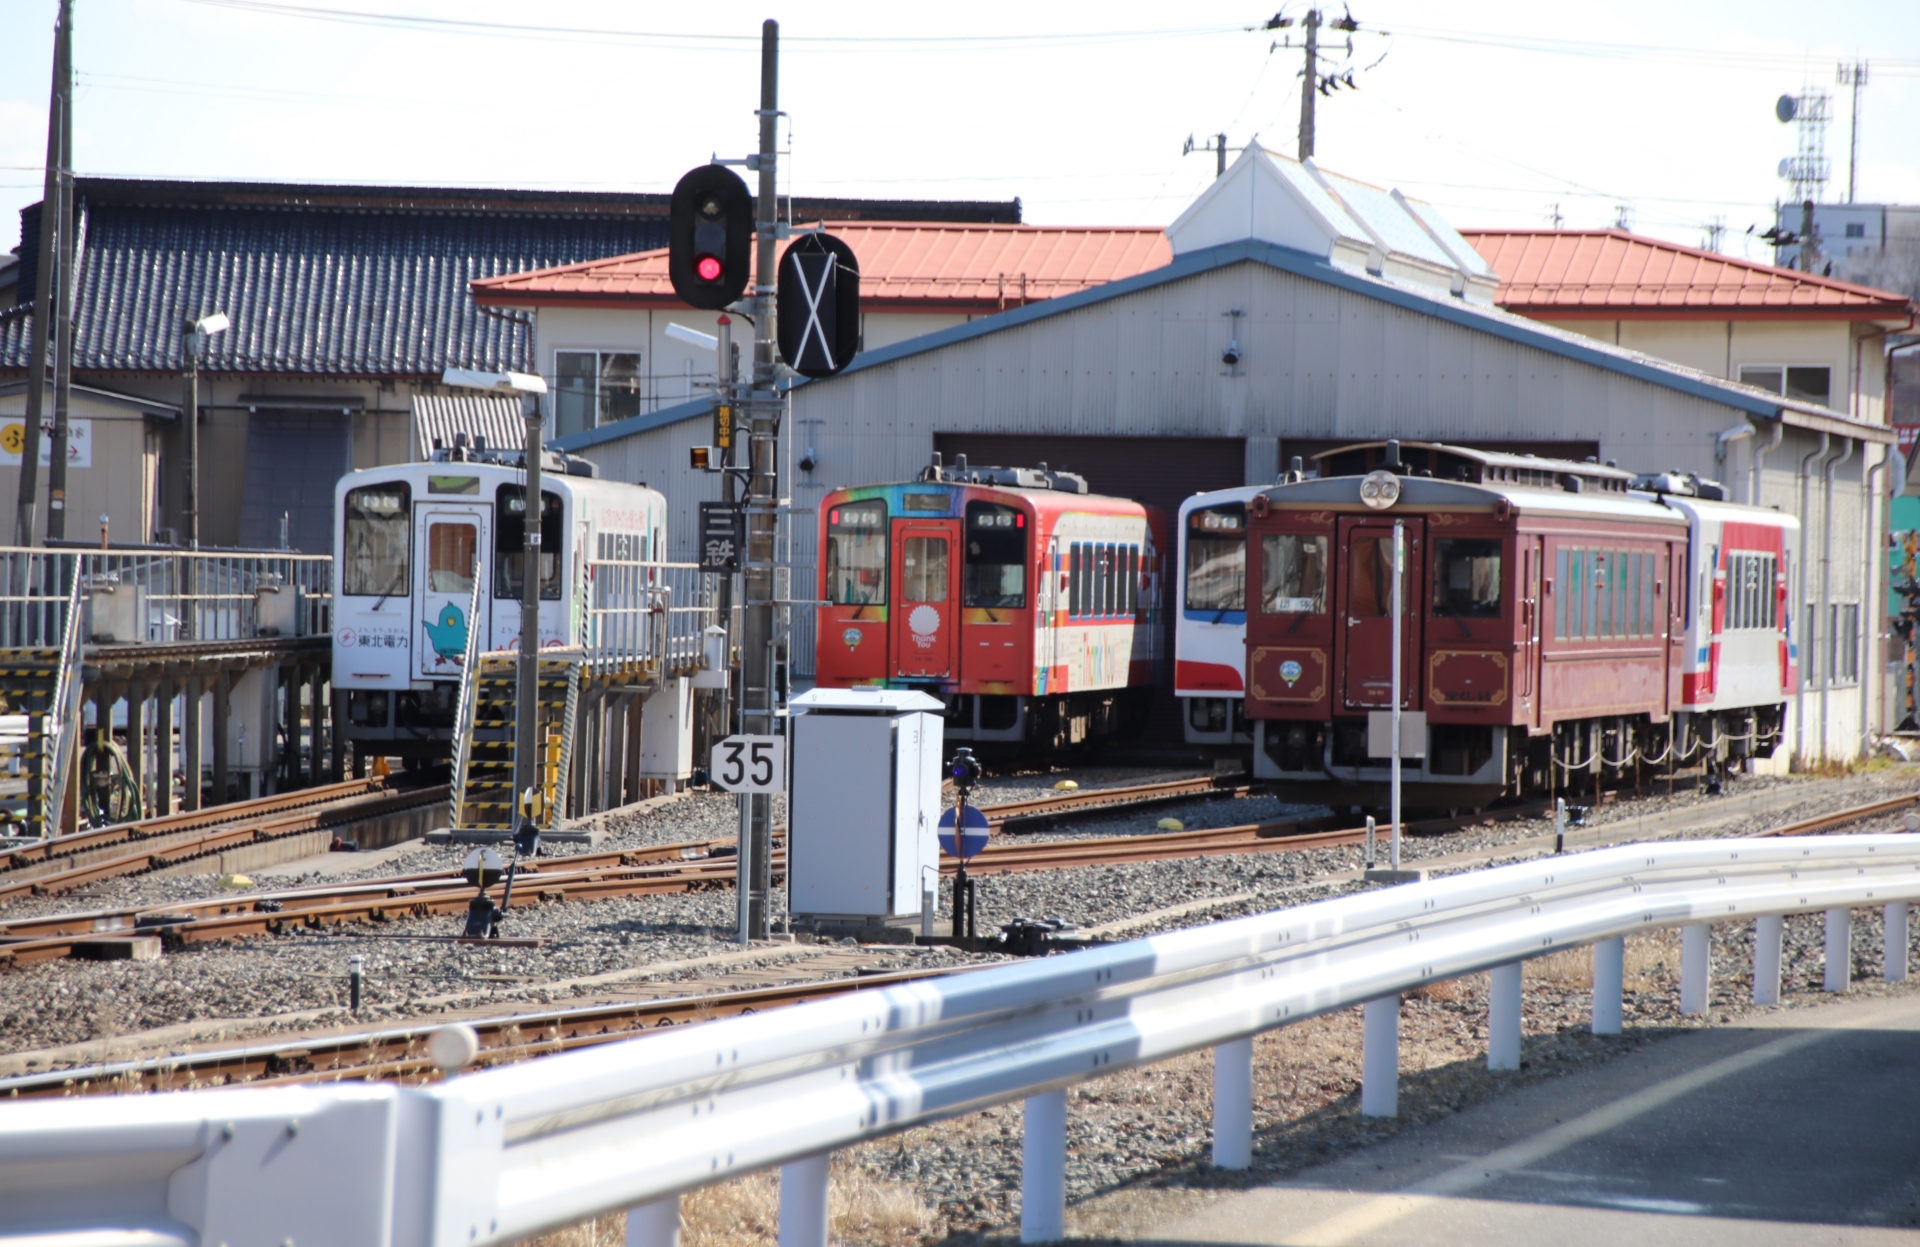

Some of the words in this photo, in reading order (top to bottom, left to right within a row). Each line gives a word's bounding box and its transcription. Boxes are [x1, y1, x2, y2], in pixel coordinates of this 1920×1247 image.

[705, 508, 735, 566] 三鉄
[358, 634, 408, 648] 東北電力
[911, 634, 937, 643] Thank
[916, 640, 931, 649] You
[722, 742, 774, 787] 35
